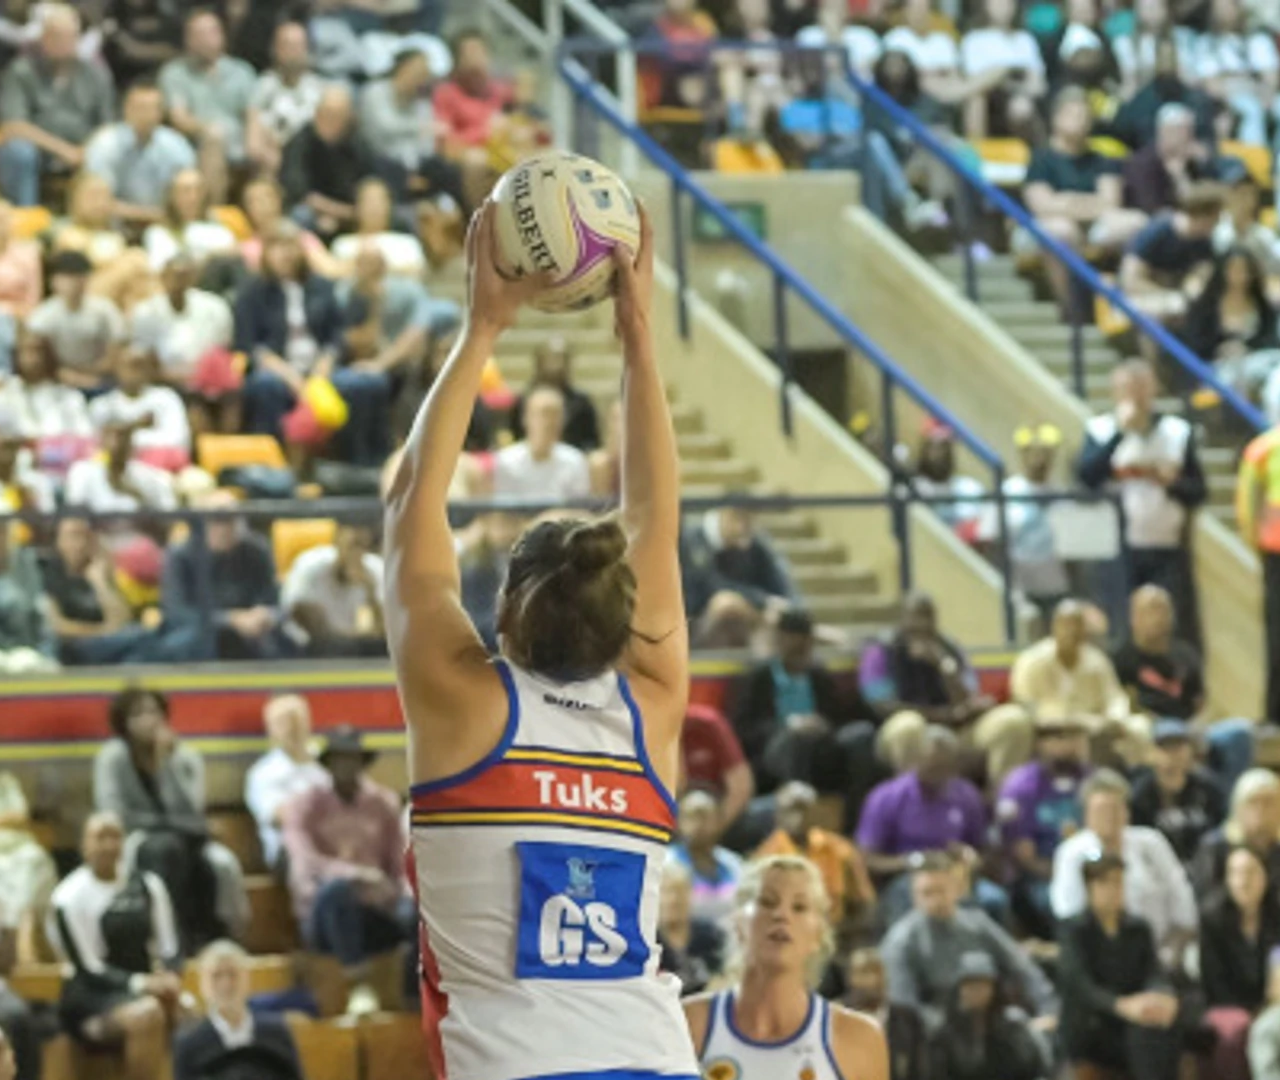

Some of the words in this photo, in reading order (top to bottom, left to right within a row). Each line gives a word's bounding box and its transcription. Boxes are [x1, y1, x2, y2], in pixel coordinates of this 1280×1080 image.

[513, 168, 561, 275] GILBERT
[533, 770, 628, 814] Tuks
[539, 895, 628, 966] GS
